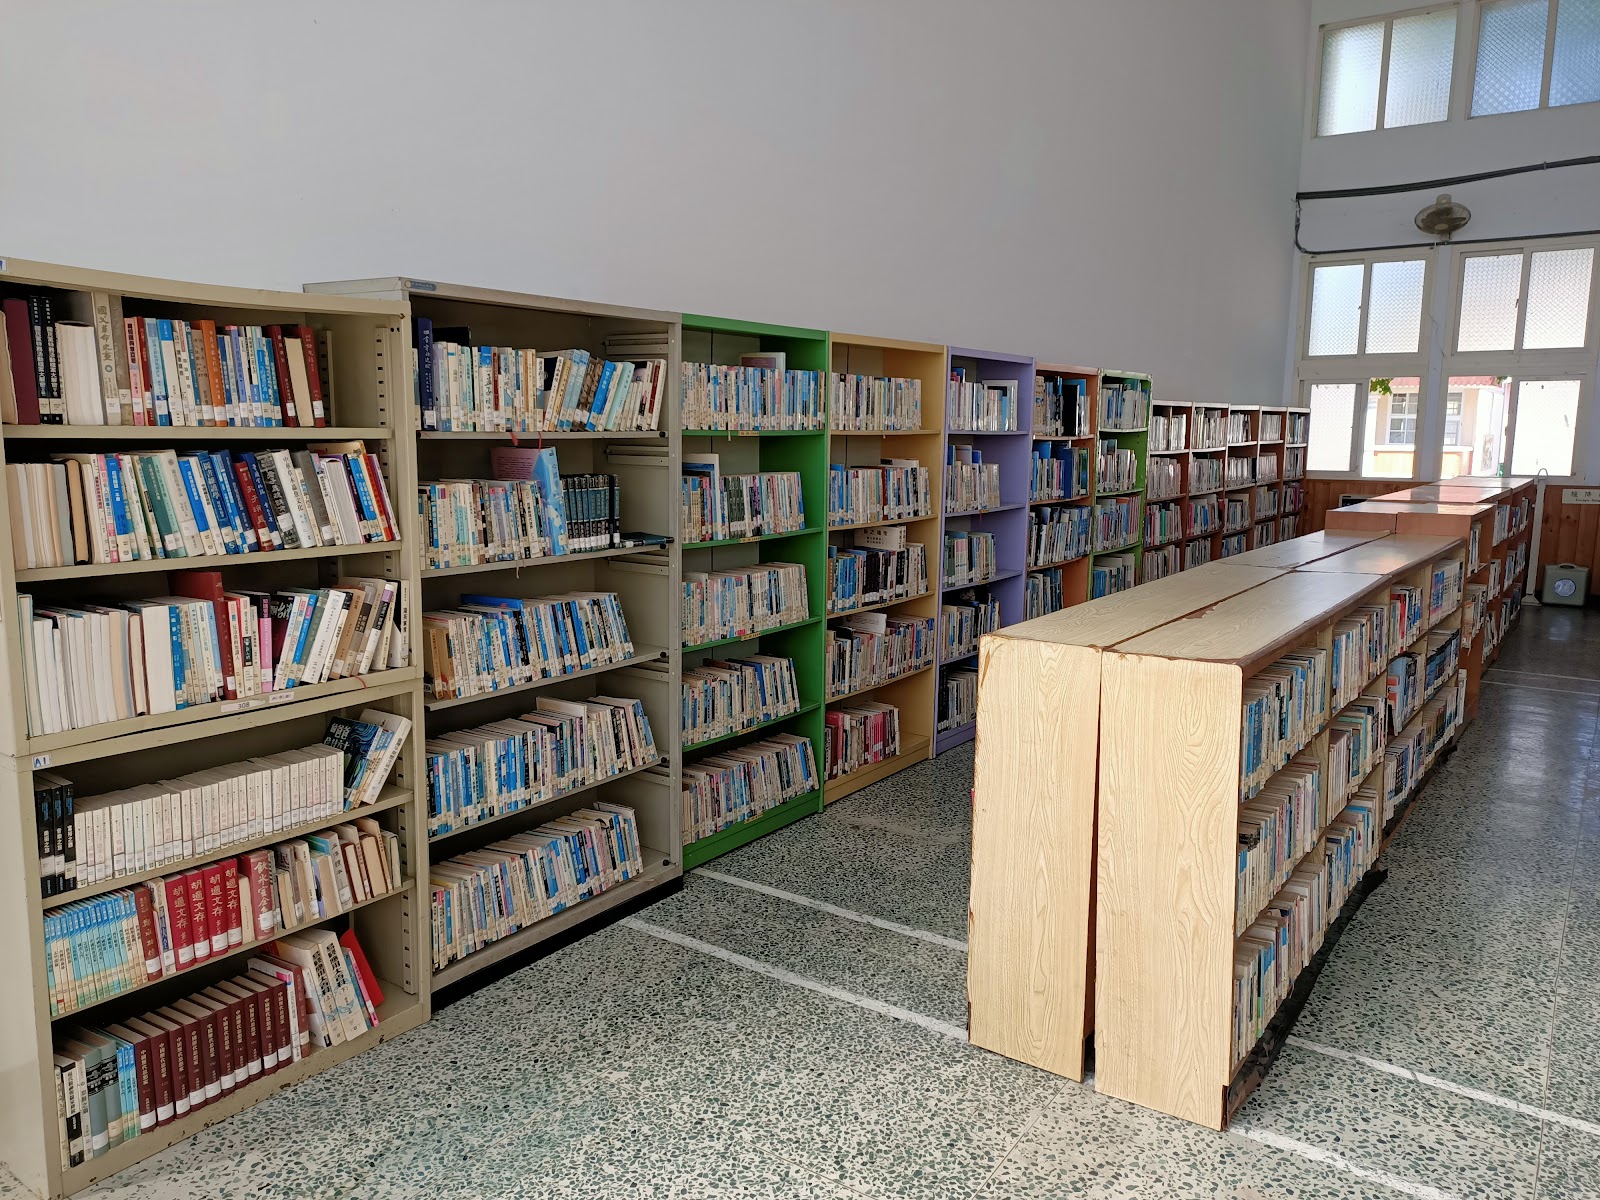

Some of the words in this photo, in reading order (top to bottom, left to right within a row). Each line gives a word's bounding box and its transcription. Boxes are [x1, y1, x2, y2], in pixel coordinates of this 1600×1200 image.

[238, 702, 250, 710] 308
[172, 885, 188, 929] 胡適文存
[190, 880, 205, 922] 胡適文存
[209, 873, 223, 917] 胡適文存
[225, 867, 238, 910] 胡適文存
